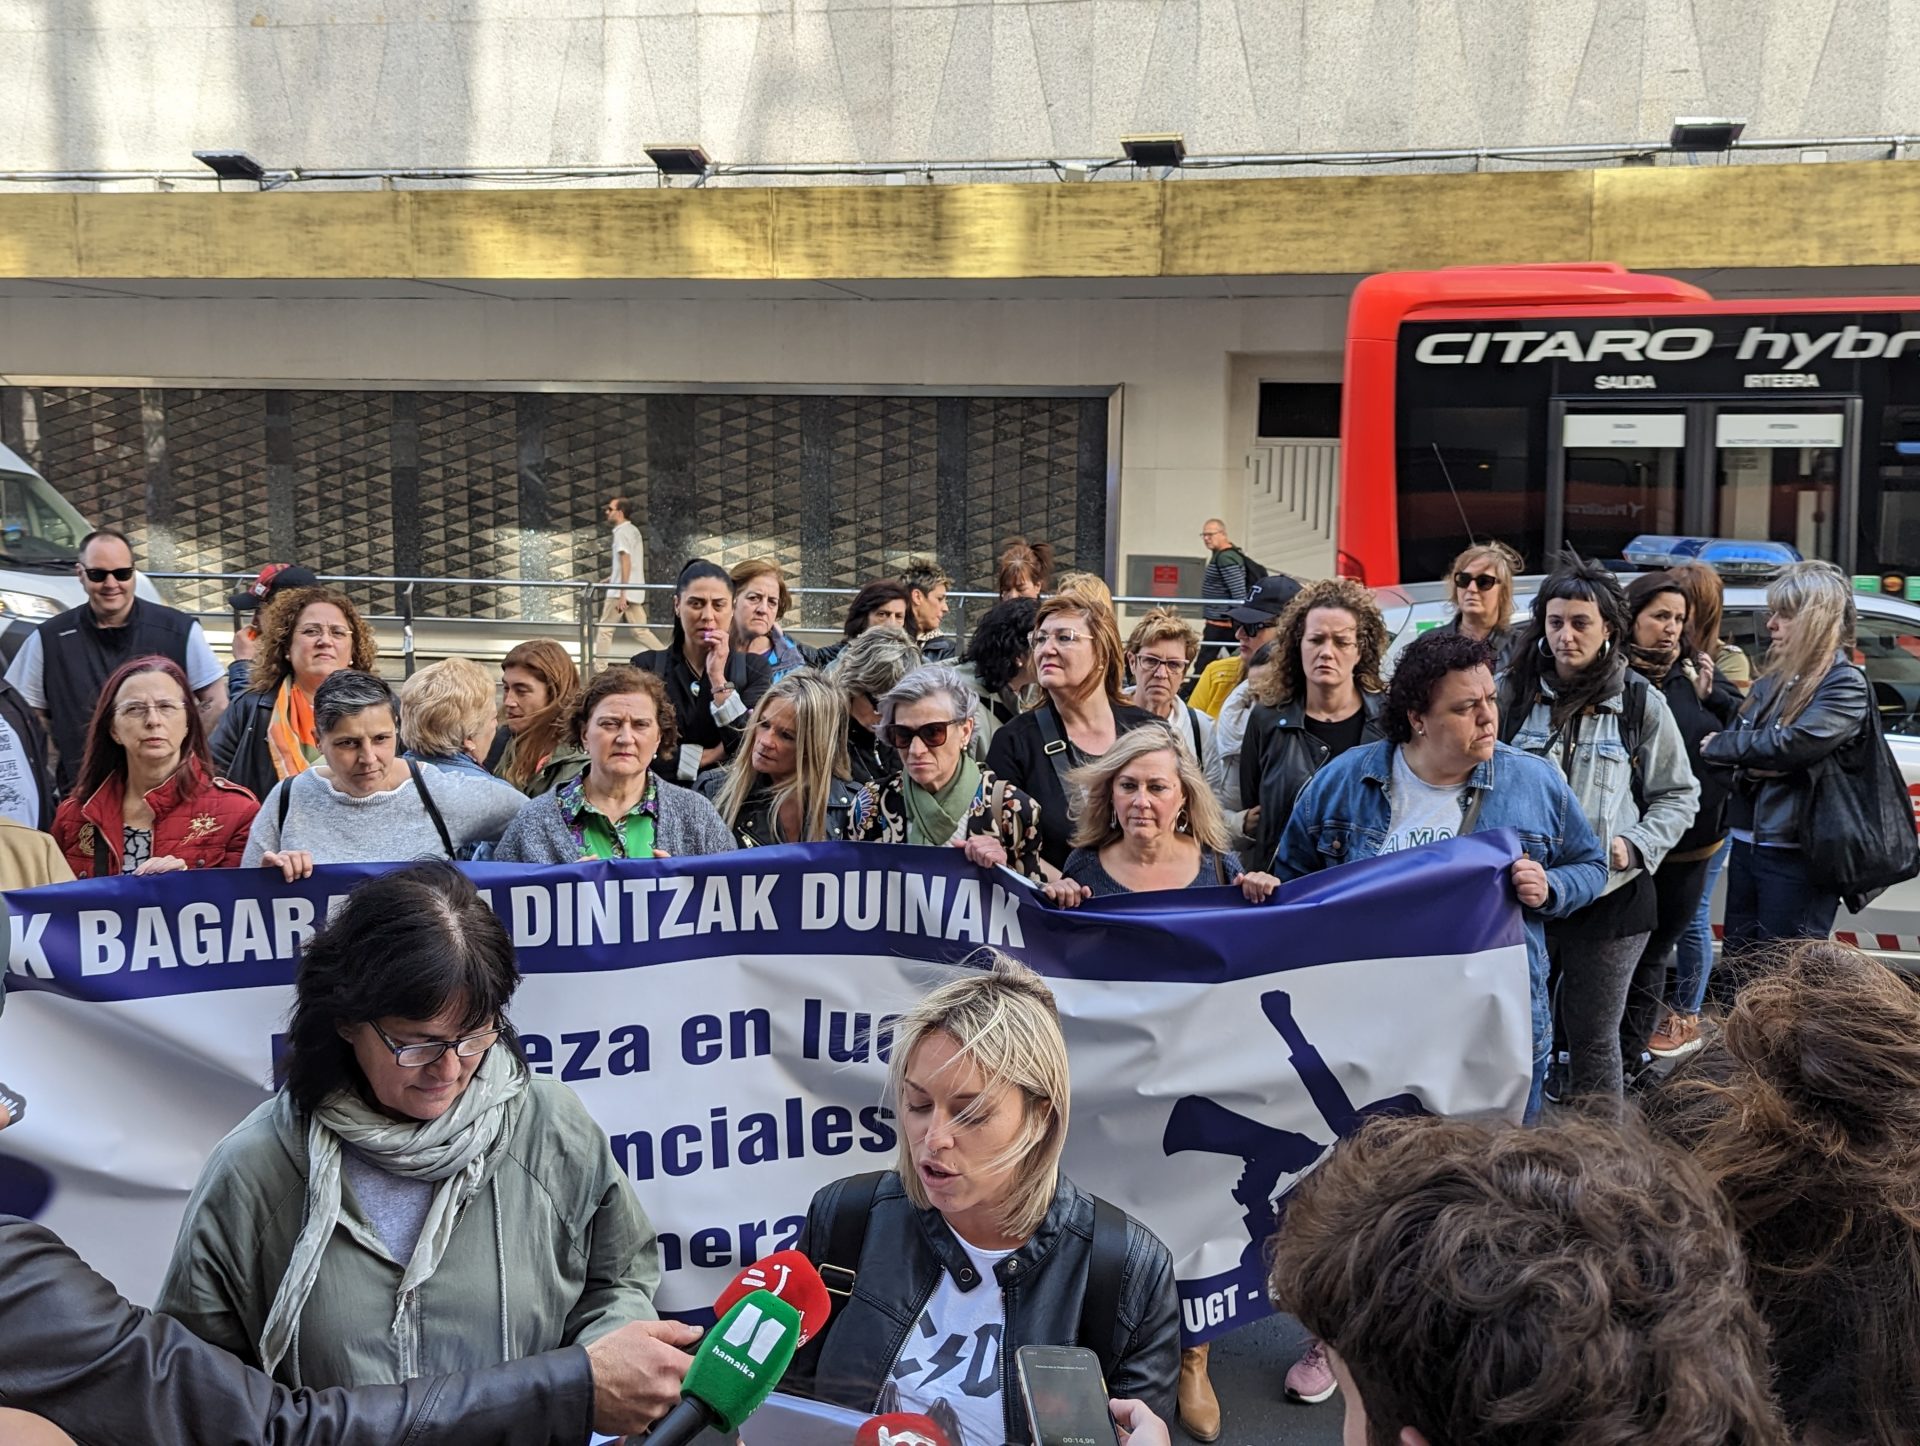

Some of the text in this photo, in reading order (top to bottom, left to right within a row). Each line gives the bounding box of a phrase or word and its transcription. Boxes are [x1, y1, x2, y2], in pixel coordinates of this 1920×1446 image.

[1414, 325, 1920, 369] CITARO hybr
[1594, 375, 1657, 390] SALIDA
[1743, 373, 1820, 388] IRTEERA
[6, 870, 1025, 979] K BAGAR DINTZAK DUINAK
[520, 1024, 650, 1082] eza
[681, 1008, 771, 1065] en
[610, 1097, 898, 1181] nciales
[1182, 1283, 1239, 1333] UGT
[712, 1345, 756, 1380] hamaika
